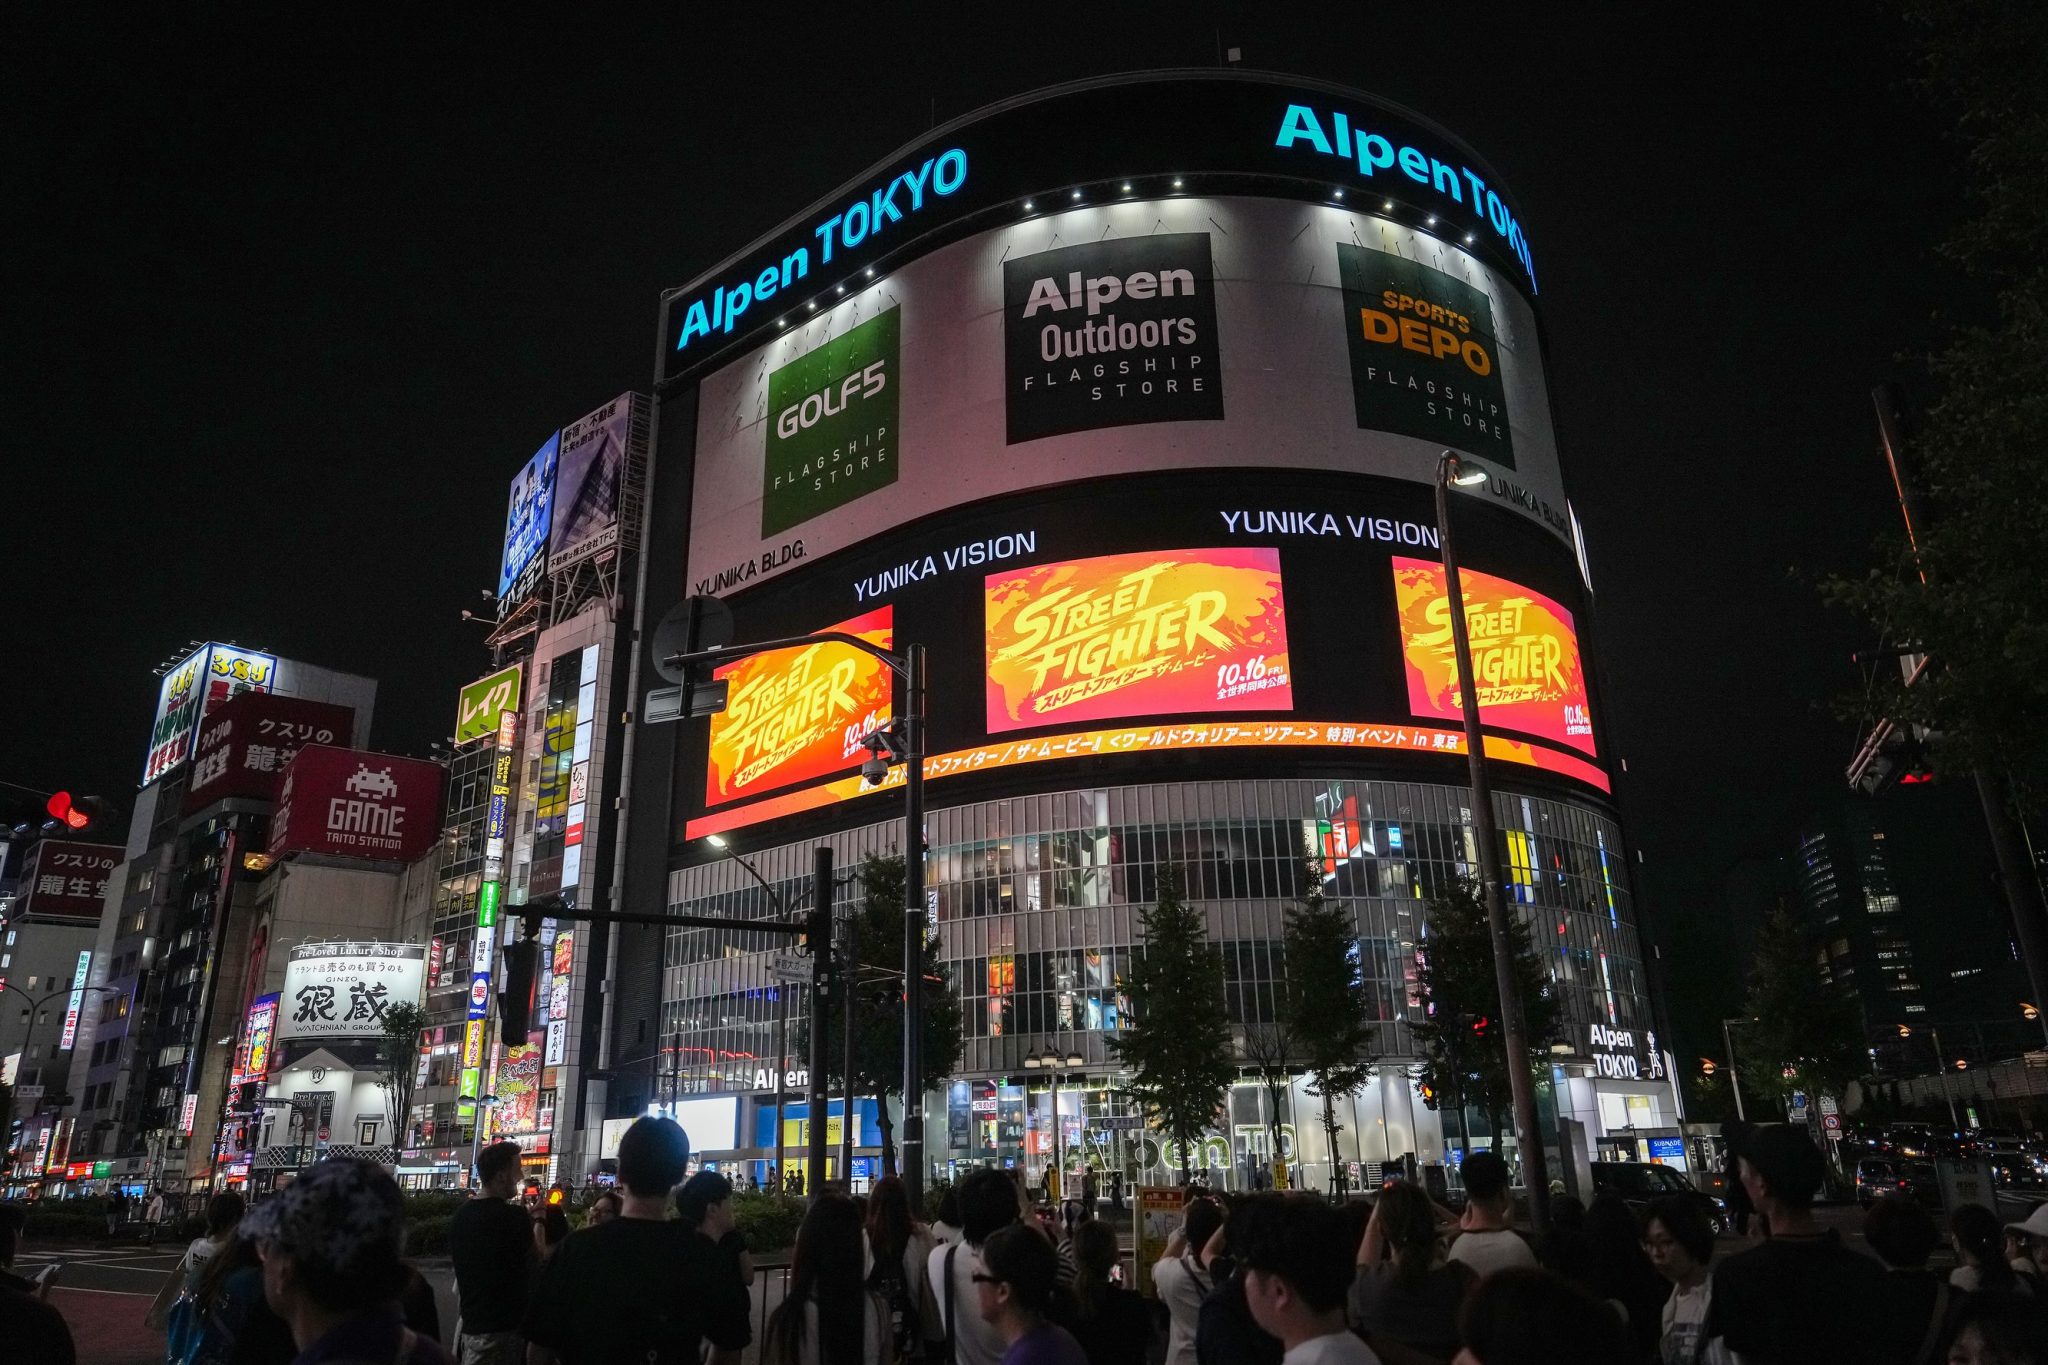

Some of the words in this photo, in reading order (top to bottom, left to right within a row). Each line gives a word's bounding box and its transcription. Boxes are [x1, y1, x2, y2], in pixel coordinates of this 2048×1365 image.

[1275, 103, 1463, 203] Alpen
[677, 245, 809, 352] Alpen
[815, 148, 968, 265] TOKYO
[1022, 268, 1196, 319] Alpen
[1383, 289, 1471, 334] SPORTS
[1041, 314, 1197, 362] Outdoors
[1360, 307, 1491, 377] DEPO
[1024, 355, 1202, 391] FLAGSHIP
[1091, 378, 1204, 401] STORE
[1367, 366, 1498, 417] FLAGSHIP
[776, 359, 886, 440] GOLF5
[1427, 401, 1502, 441] STORE
[774, 426, 886, 490] FLAGSHIP
[814, 447, 886, 491] STORE
[1220, 510, 1342, 537] YUNIKA
[1346, 515, 1439, 549] VISION
[695, 558, 757, 597] YUNIKA
[761, 539, 808, 572] BLDG.
[853, 555, 938, 603] YUNIKA
[943, 530, 1037, 572] VISION
[994, 561, 1182, 662] STREET
[1022, 590, 1238, 697] FIGHTER
[1042, 668, 1149, 712] ストリートファイター
[1216, 654, 1267, 688] 10.16
[1267, 665, 1284, 676] FRI
[1216, 674, 1288, 701] 全世界同時公開
[461, 679, 513, 726] レイク
[715, 642, 826, 746] STREET
[731, 657, 860, 769] FIGHTER
[1458, 687, 1530, 706] リートファイター
[258, 717, 335, 745] クスリの
[843, 709, 877, 749] 10.16
[1564, 703, 1584, 726] 10.16
[201, 718, 233, 752] クスリの
[1326, 726, 1407, 746] 特別イベント
[1413, 731, 1427, 746] in
[1432, 732, 1460, 750] 東京
[327, 797, 406, 837] GAME
[326, 831, 356, 845] TAITO
[359, 835, 402, 850] STATION
[53, 852, 115, 871] クスリの
[298, 946, 337, 958] Pre-Loved
[340, 946, 375, 956] Luxury
[377, 946, 404, 957] Shop
[293, 981, 389, 1023] 銀蔵
[295, 1023, 347, 1032] WATCHNIAN
[1590, 1023, 1634, 1051] Alpen
[1592, 1053, 1638, 1077] TOKYO
[1653, 1139, 1682, 1147] SUBNADE
